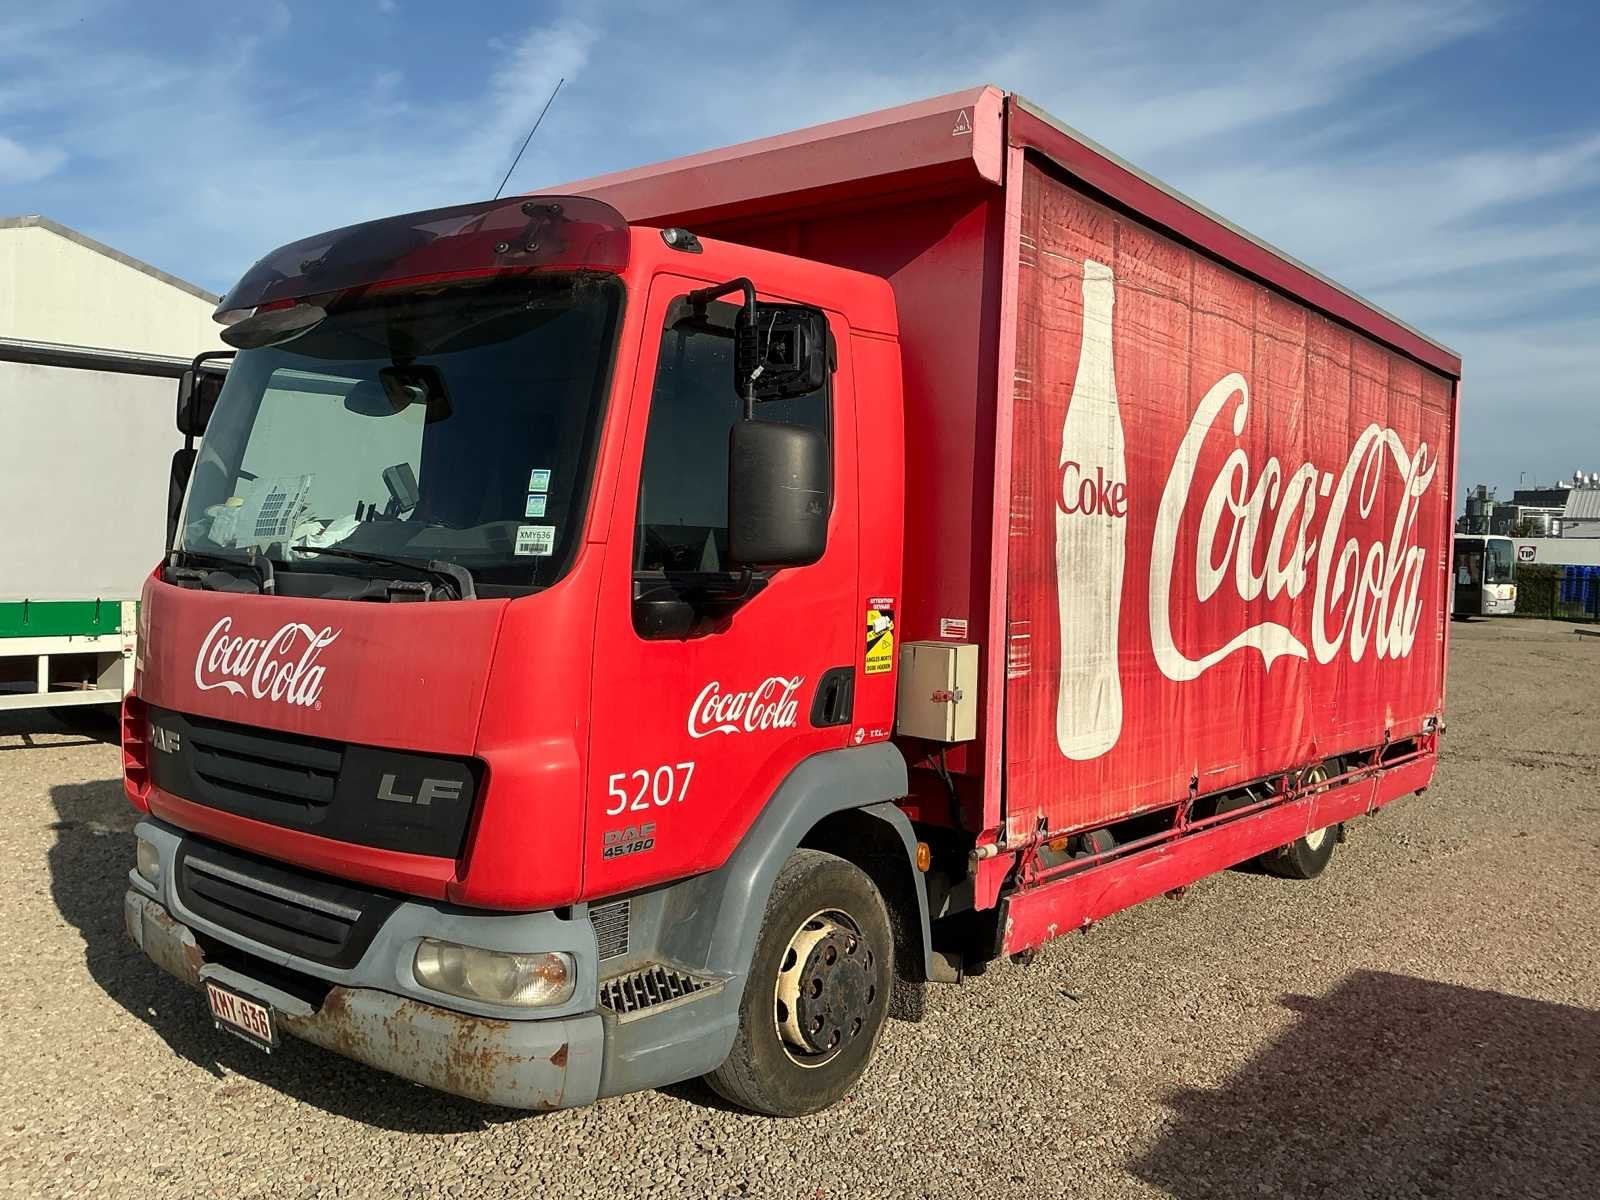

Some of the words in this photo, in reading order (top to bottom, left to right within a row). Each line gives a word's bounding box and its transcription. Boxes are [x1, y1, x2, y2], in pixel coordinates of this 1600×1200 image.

[1056, 460, 1128, 518] Coke
[520, 530, 551, 540] XMY636
[1149, 372, 1437, 681] Coca-Cola
[1520, 550, 1535, 558] TIP
[195, 616, 343, 708] Coca-Cola
[687, 675, 806, 739] Coca-Cola
[376, 774, 464, 805] LF
[606, 761, 695, 816] 5207
[604, 822, 656, 845] DAF
